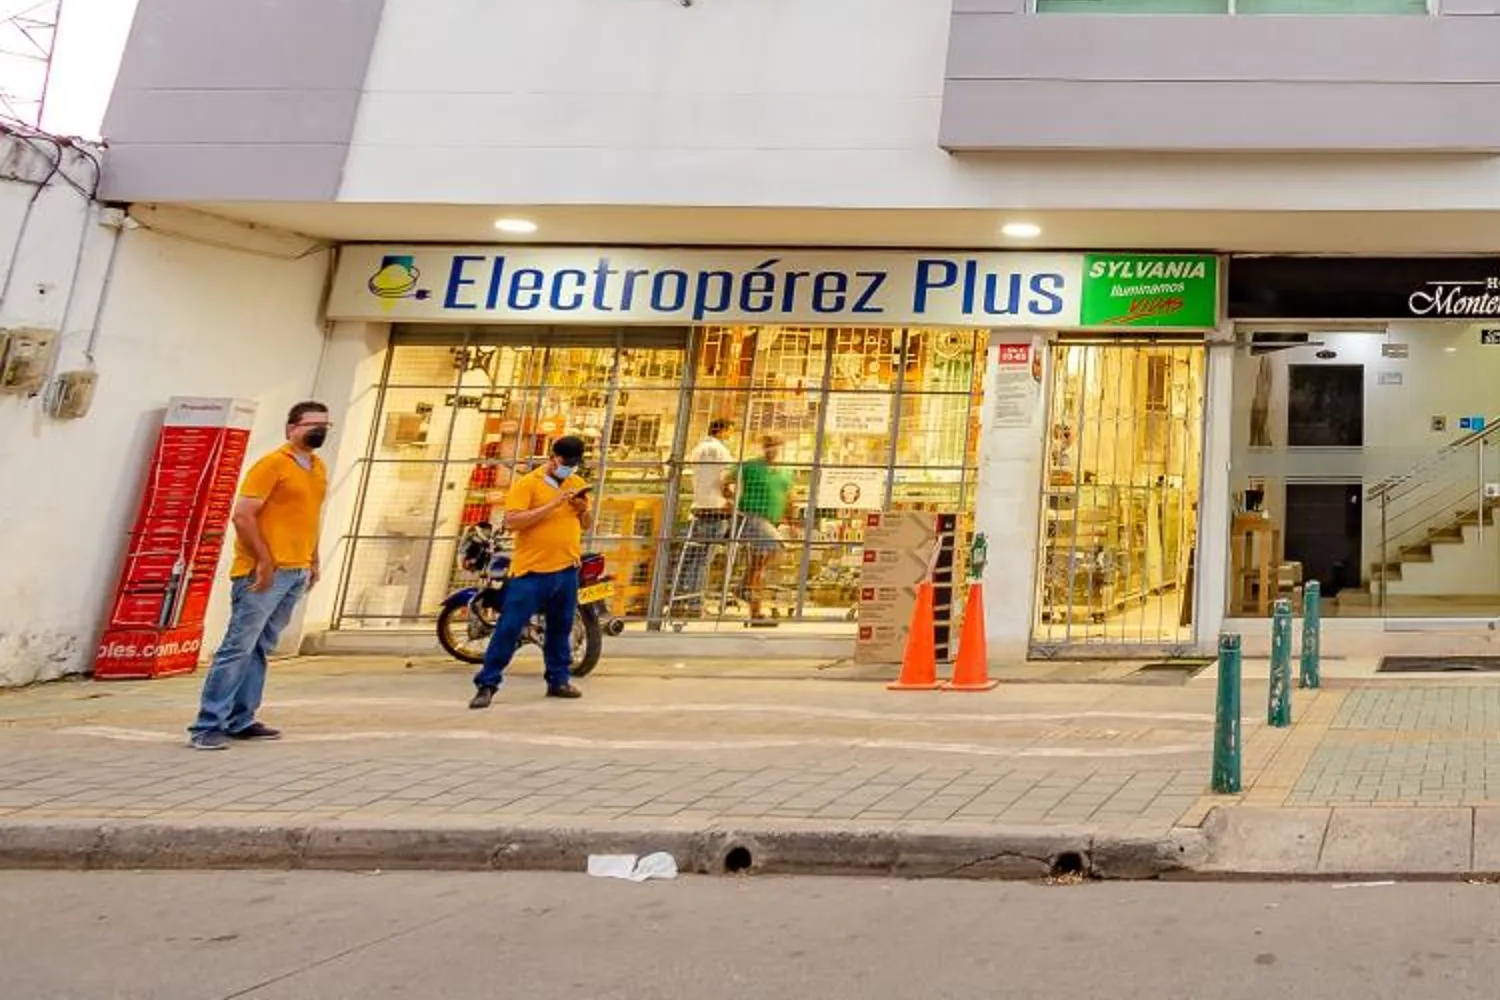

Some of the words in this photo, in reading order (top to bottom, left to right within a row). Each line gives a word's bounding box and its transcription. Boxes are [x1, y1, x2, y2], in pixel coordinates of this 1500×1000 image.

[1088, 261, 1206, 279] SYLVANIA
[443, 255, 888, 321] Electropérez
[912, 259, 1066, 315] Plus
[1110, 282, 1185, 297] Iluminamos
